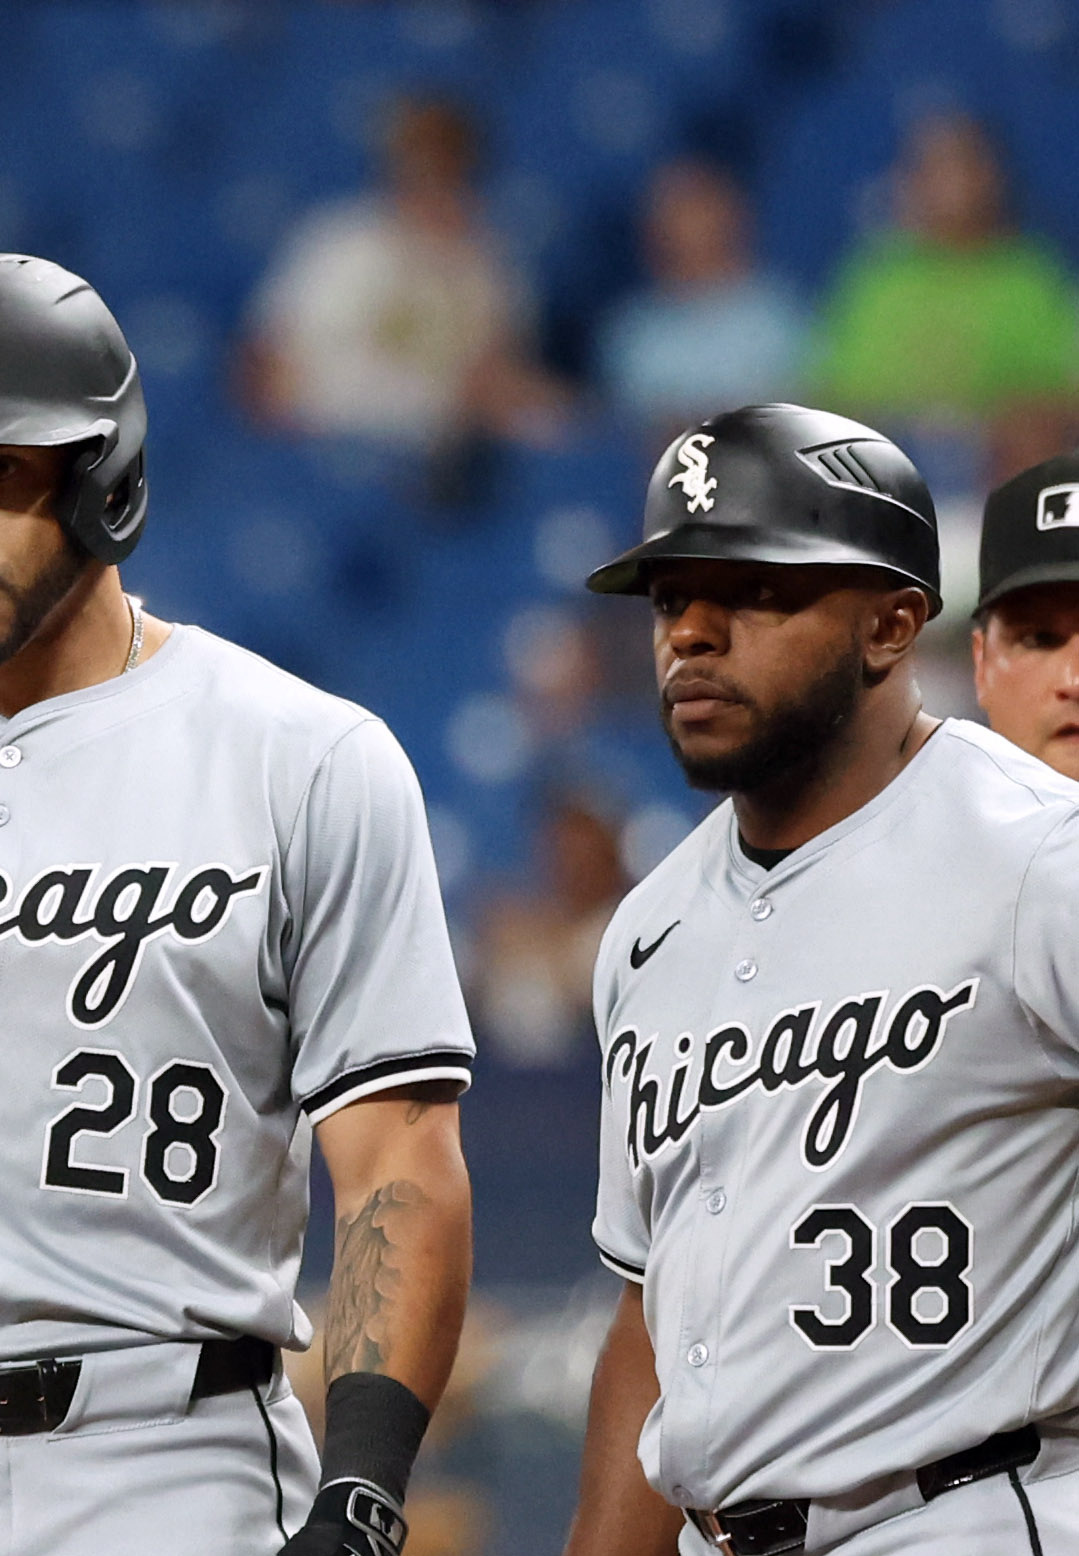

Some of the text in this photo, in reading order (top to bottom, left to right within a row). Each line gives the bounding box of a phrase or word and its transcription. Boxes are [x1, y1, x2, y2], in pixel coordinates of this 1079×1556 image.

[667, 433, 718, 514] Sox
[40, 1047, 228, 1209] 28
[788, 1201, 975, 1350] 38
